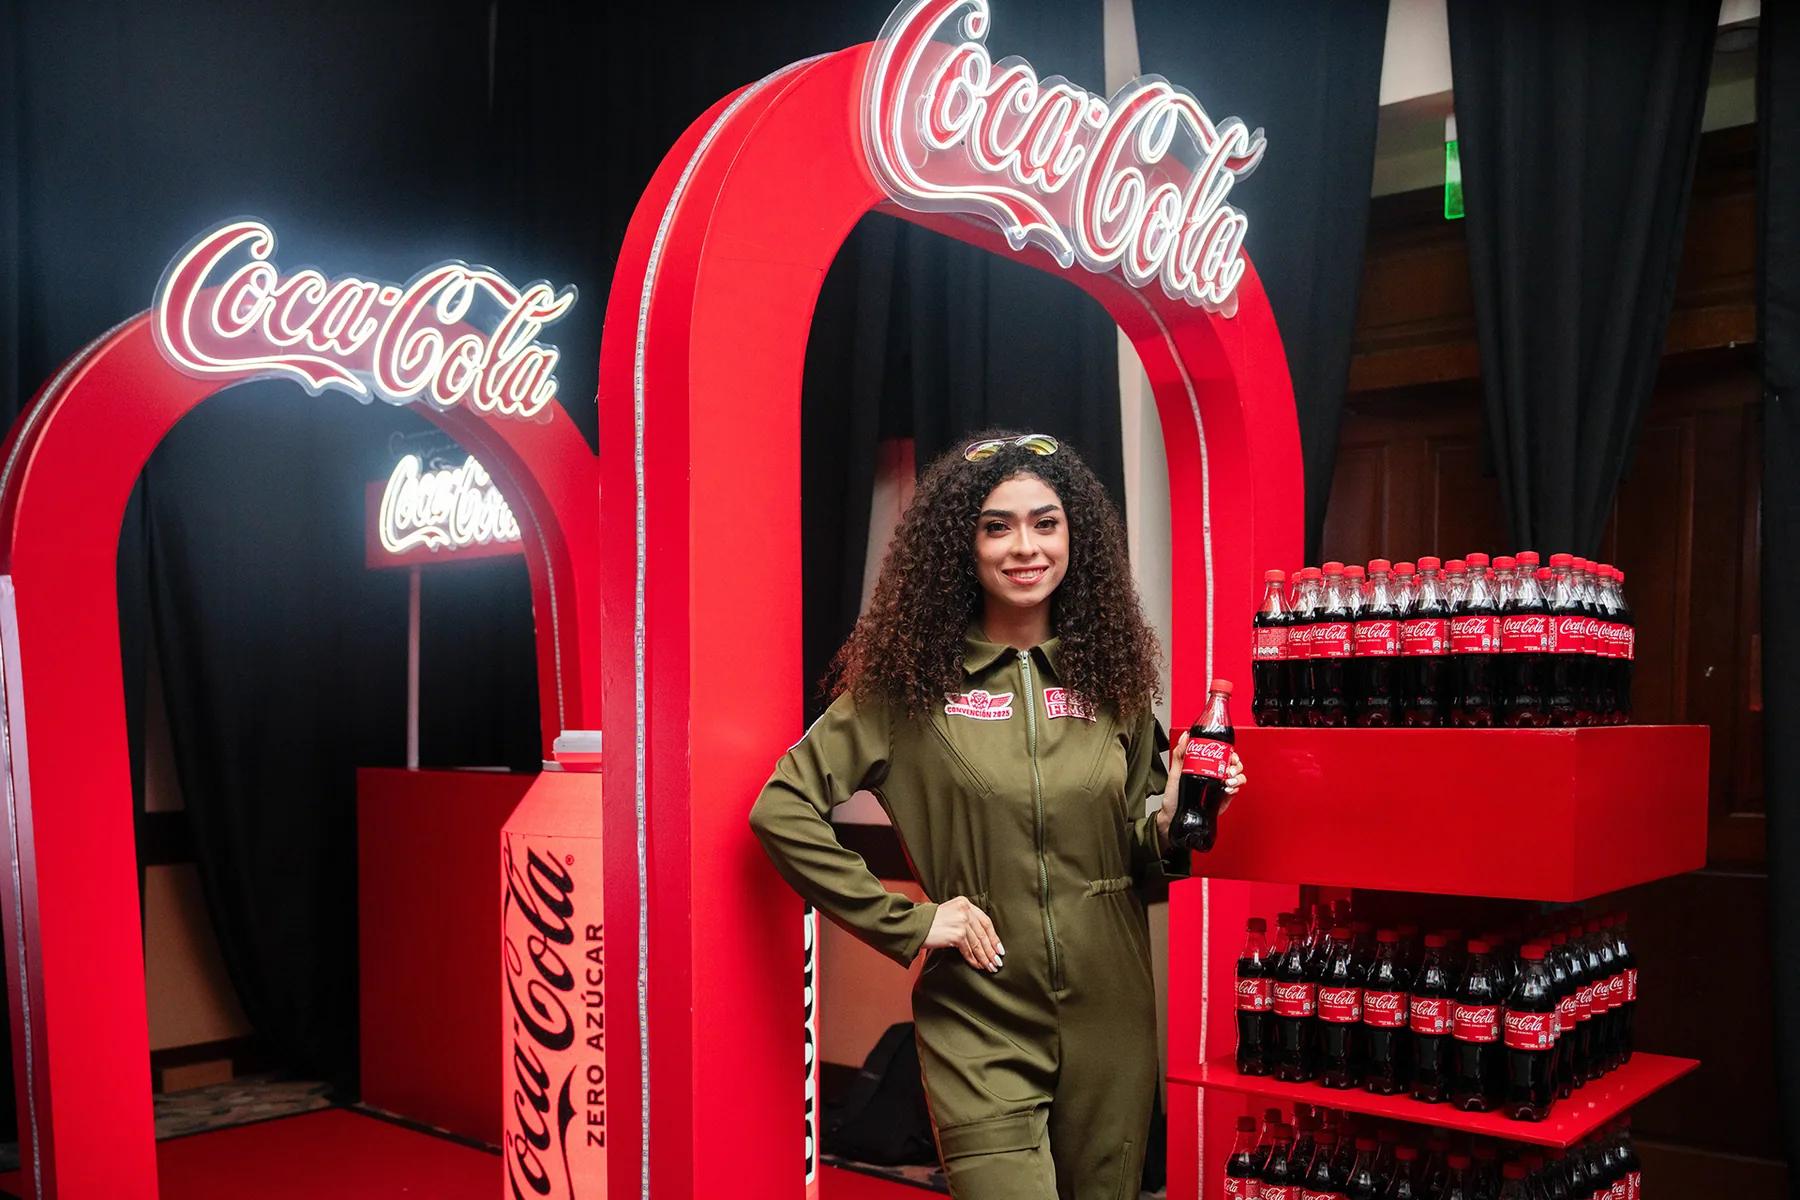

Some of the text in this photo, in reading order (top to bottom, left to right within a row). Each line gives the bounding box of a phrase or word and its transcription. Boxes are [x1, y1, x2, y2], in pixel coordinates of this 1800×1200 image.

[875, 0, 1267, 303] Coca-Cola
[160, 221, 574, 417] Coca-Cola
[1503, 617, 1546, 634] Coca-Cola
[947, 706, 1010, 718] CONVENCIÓN 2025
[1050, 704, 1090, 717] FEMS
[1186, 739, 1227, 759] Coca-Cola
[1319, 987, 1358, 1005] Coca-Cola
[1364, 991, 1401, 1009] Coca-Cola
[1455, 1006, 1497, 1024] Coca-Cola
[581, 923, 605, 1148] ZERO AZÚCAR
